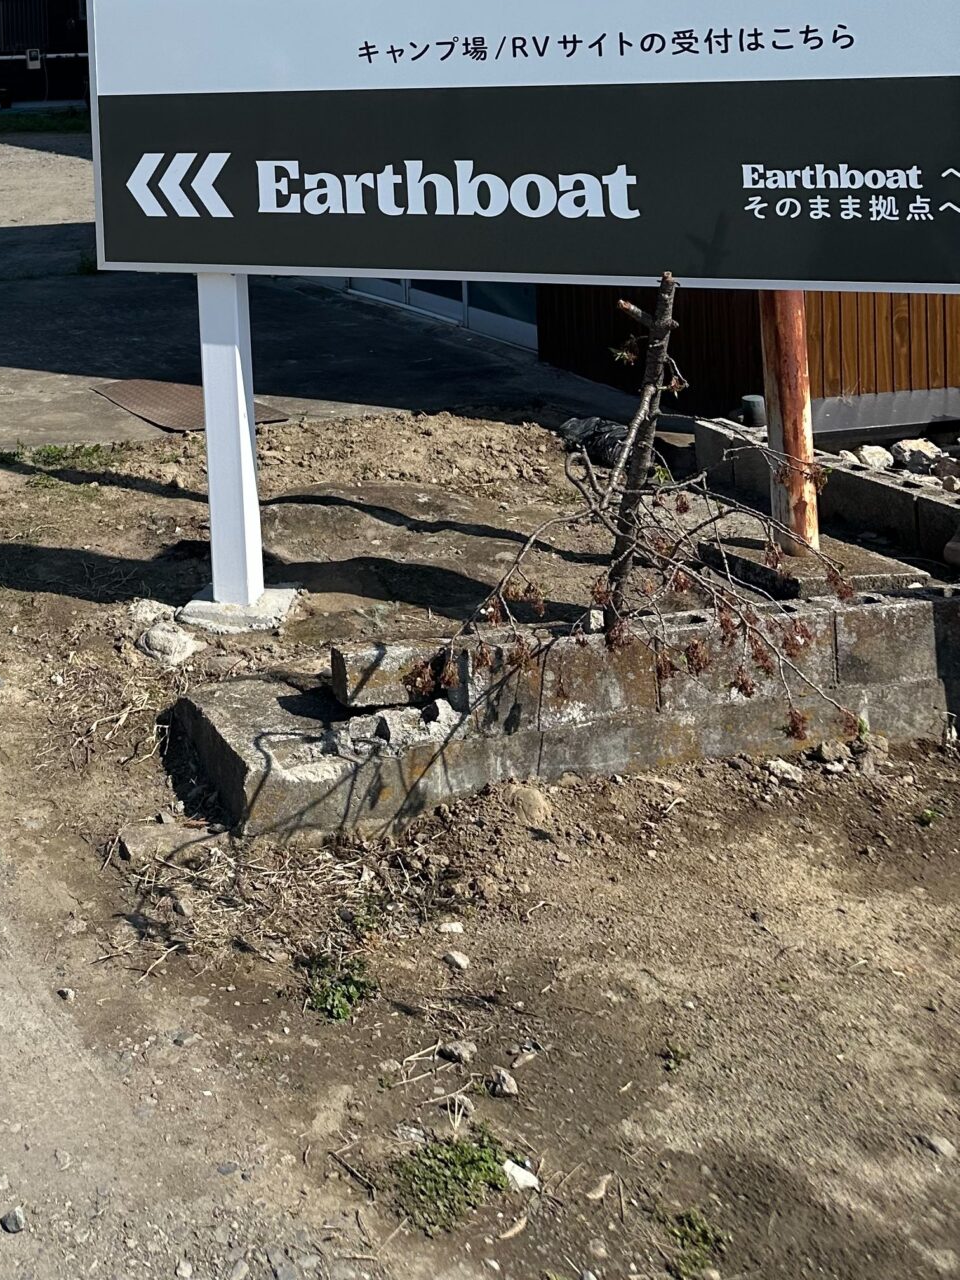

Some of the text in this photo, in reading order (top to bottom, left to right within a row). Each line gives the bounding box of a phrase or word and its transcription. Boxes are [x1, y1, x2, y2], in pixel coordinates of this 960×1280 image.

[358, 23, 856, 64] キャンプ場/RVサイトの受付はこちら
[255, 159, 641, 220] Earthboat
[741, 163, 924, 190] Earthboat
